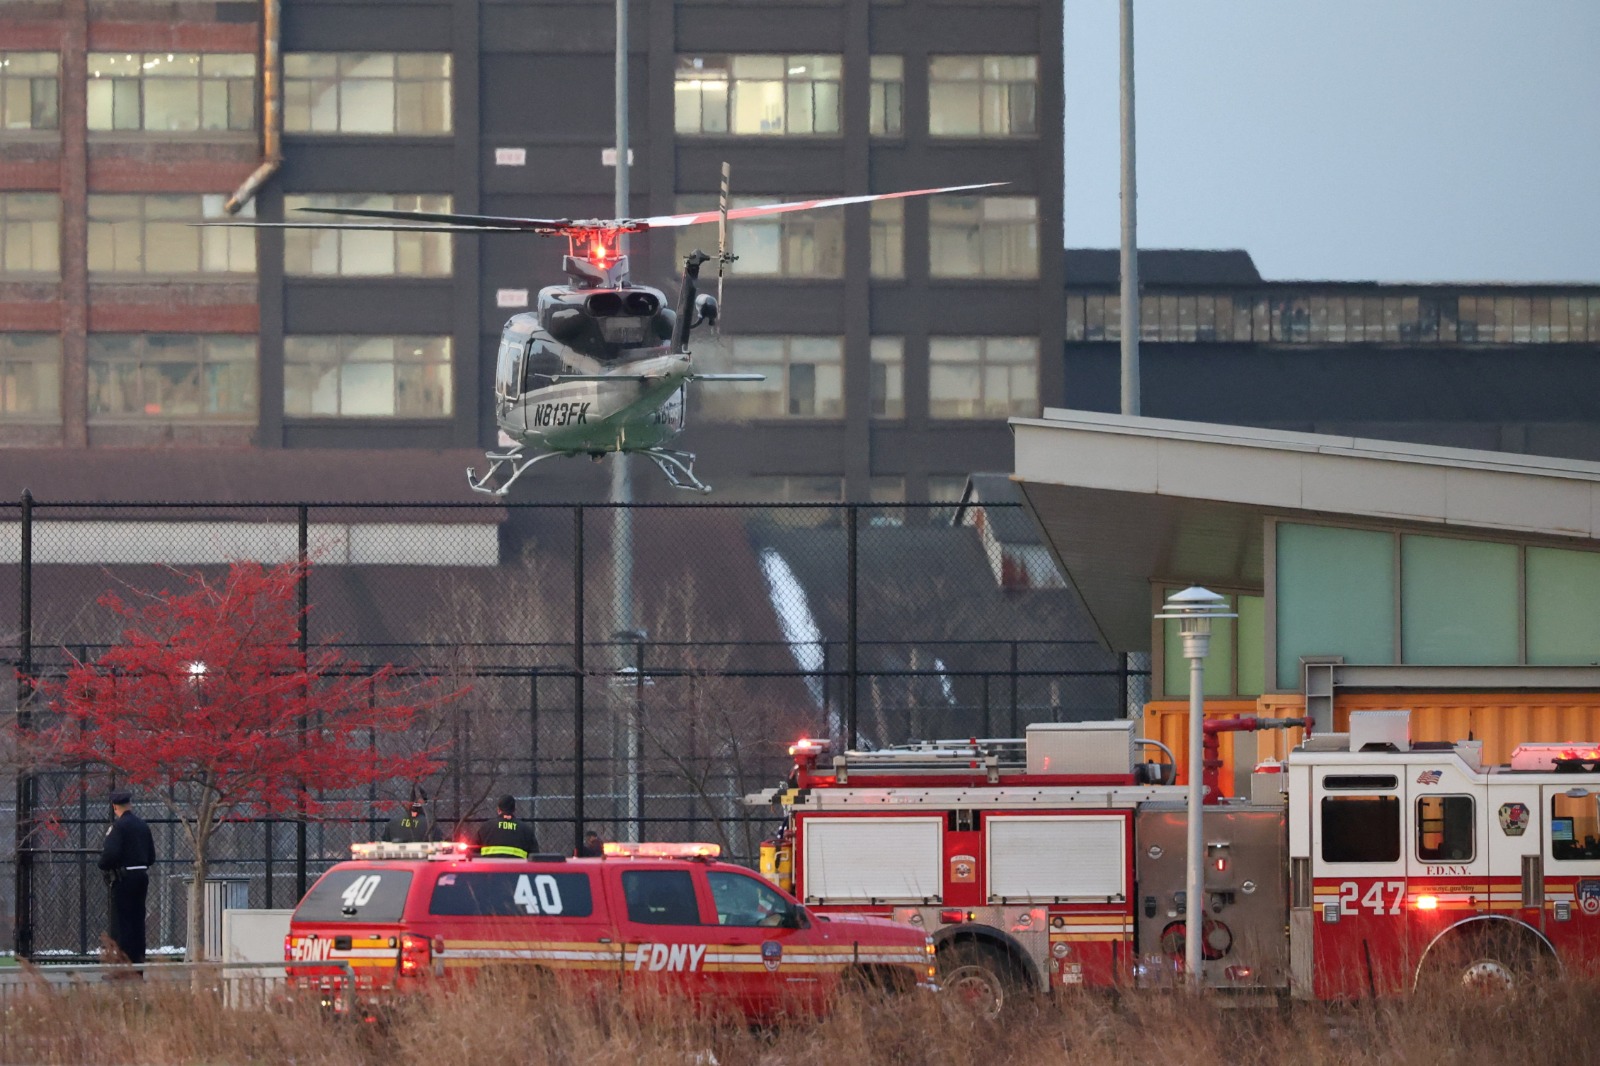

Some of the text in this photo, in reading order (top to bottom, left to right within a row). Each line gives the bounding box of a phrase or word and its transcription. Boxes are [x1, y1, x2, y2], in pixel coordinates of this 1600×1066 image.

[534, 402, 591, 426] N813FK
[401, 818, 419, 829] FDY
[498, 821, 517, 831] FDNY
[1427, 866, 1471, 875] F.D.N.Y.
[341, 875, 382, 906] 40
[513, 874, 563, 914] 40
[1340, 881, 1405, 915] 247
[296, 938, 332, 961] FDNY
[633, 943, 707, 972] FDNY
